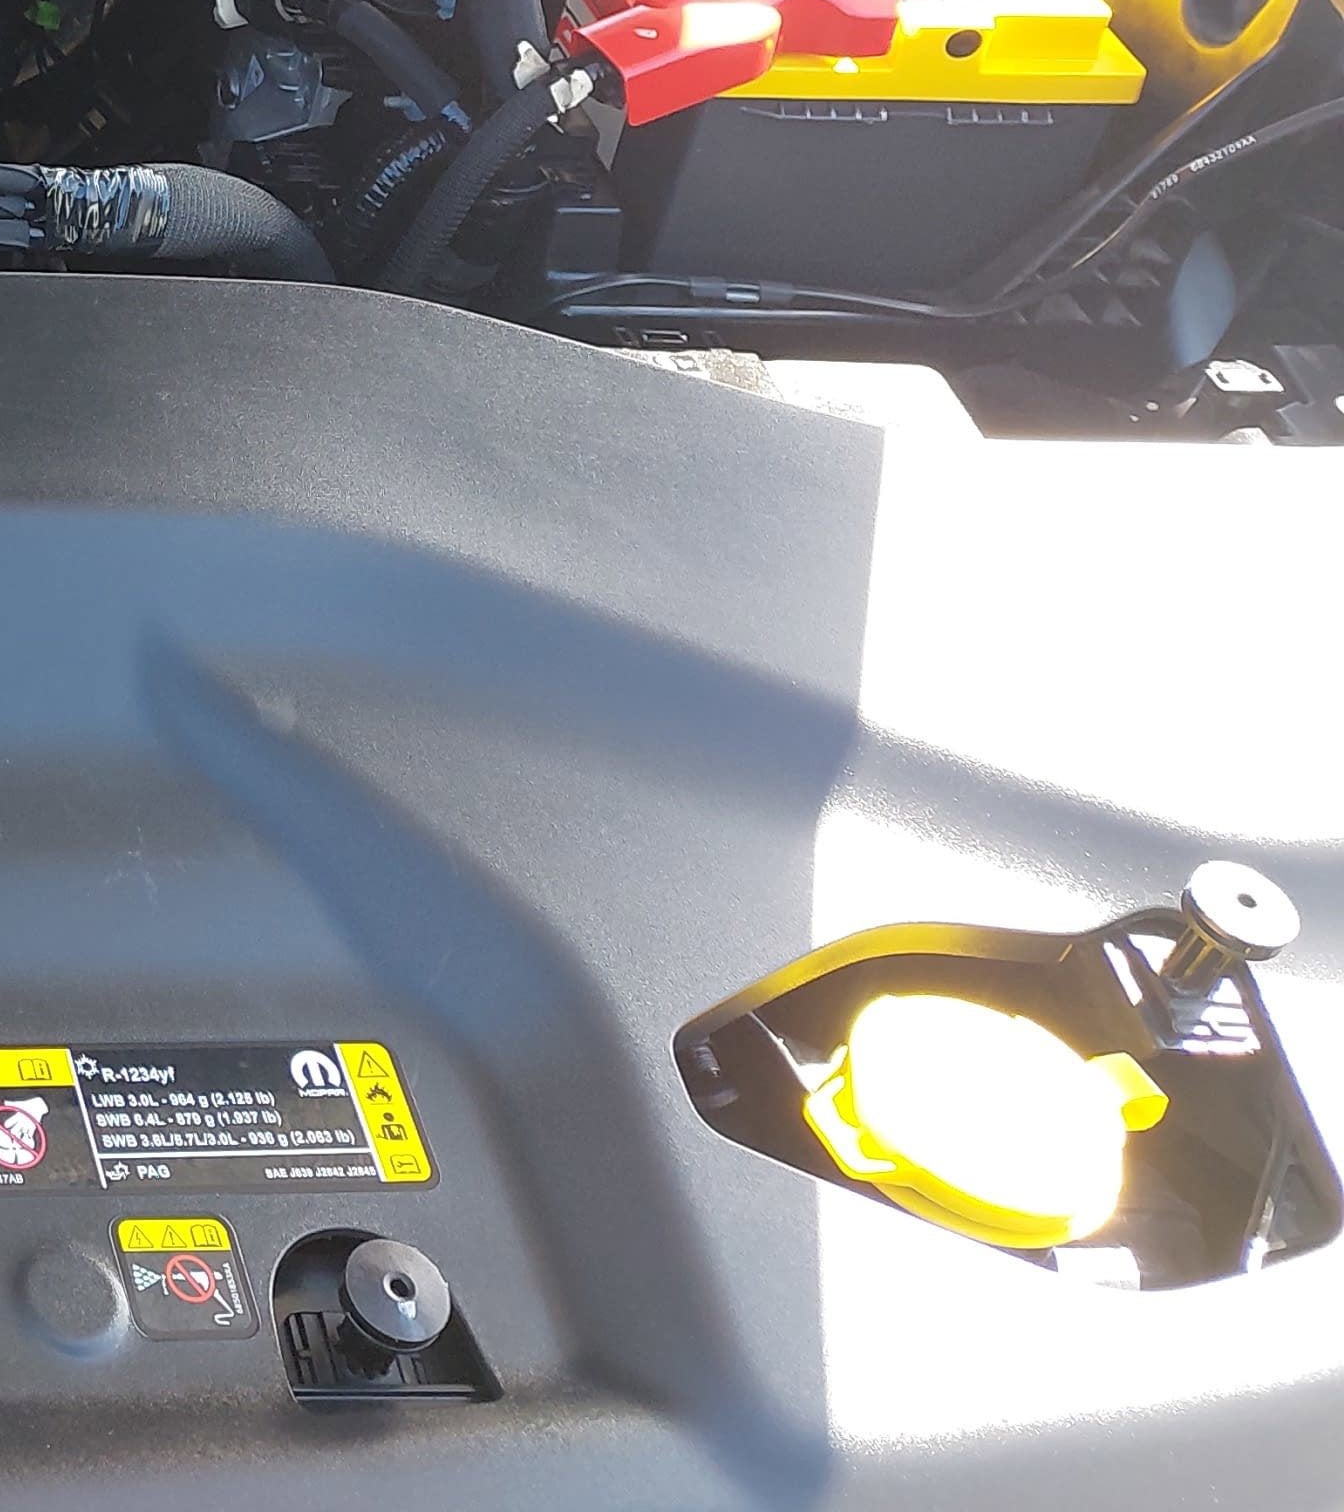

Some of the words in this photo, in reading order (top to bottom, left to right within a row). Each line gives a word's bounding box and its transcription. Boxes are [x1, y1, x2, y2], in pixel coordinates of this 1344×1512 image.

[102, 1066, 175, 1085] R-1234yf
[92, 1094, 125, 1107] LWB
[129, 1094, 159, 1107] 3.0L
[170, 1092, 195, 1106] 964
[199, 1095, 209, 1108] g
[256, 1092, 275, 1107] lb)
[96, 1113, 130, 1127] SWB
[206, 1115, 215, 1128] g
[218, 1111, 258, 1127] (1.937
[262, 1110, 282, 1127] lb)
[102, 1134, 137, 1148] SWB
[279, 1135, 288, 1147] g
[337, 1130, 355, 1146] lb)
[137, 1165, 171, 1179] PAG
[265, 1168, 288, 1178] SAE
